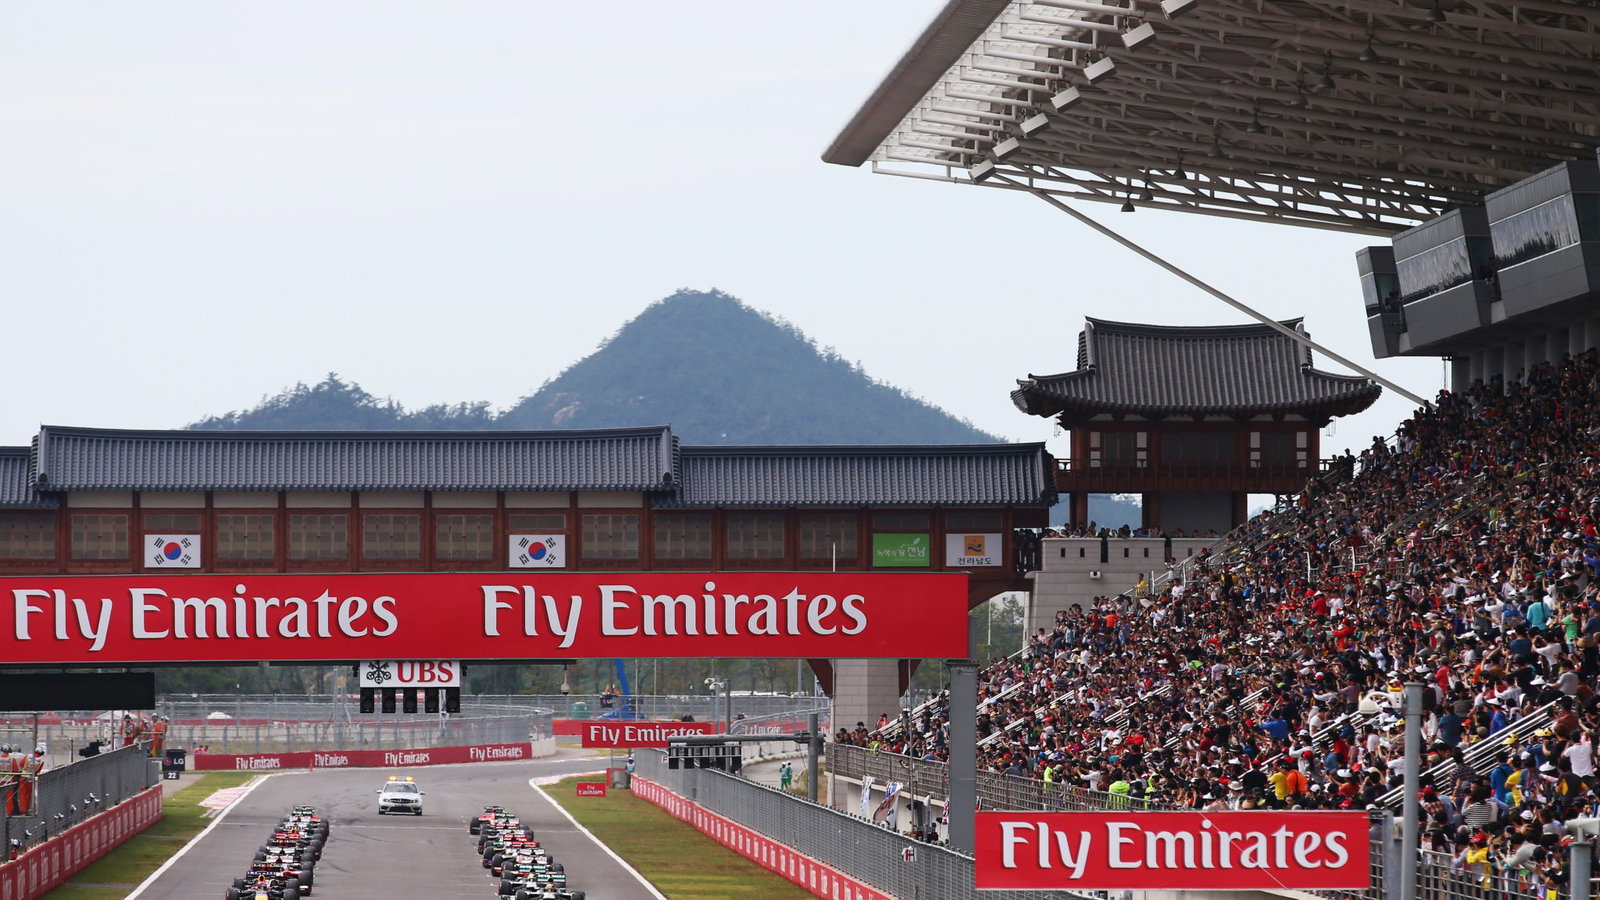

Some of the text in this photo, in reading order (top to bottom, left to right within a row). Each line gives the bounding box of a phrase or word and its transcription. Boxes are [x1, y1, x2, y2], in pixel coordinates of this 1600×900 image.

[957, 557, 993, 566] 전라남도
[12, 583, 398, 651] Fly Emirates
[482, 581, 867, 648] Fly Emirates
[396, 660, 453, 683] UBS
[589, 725, 620, 744] Fly
[314, 753, 325, 766] Fly
[385, 751, 430, 766] Fly Emirates
[469, 745, 523, 761] Fly Emirates
[173, 757, 185, 766] LG
[236, 756, 281, 770] Fly Emirates
[167, 772, 177, 780] 22
[1000, 818, 1349, 879] Fly Emirates
